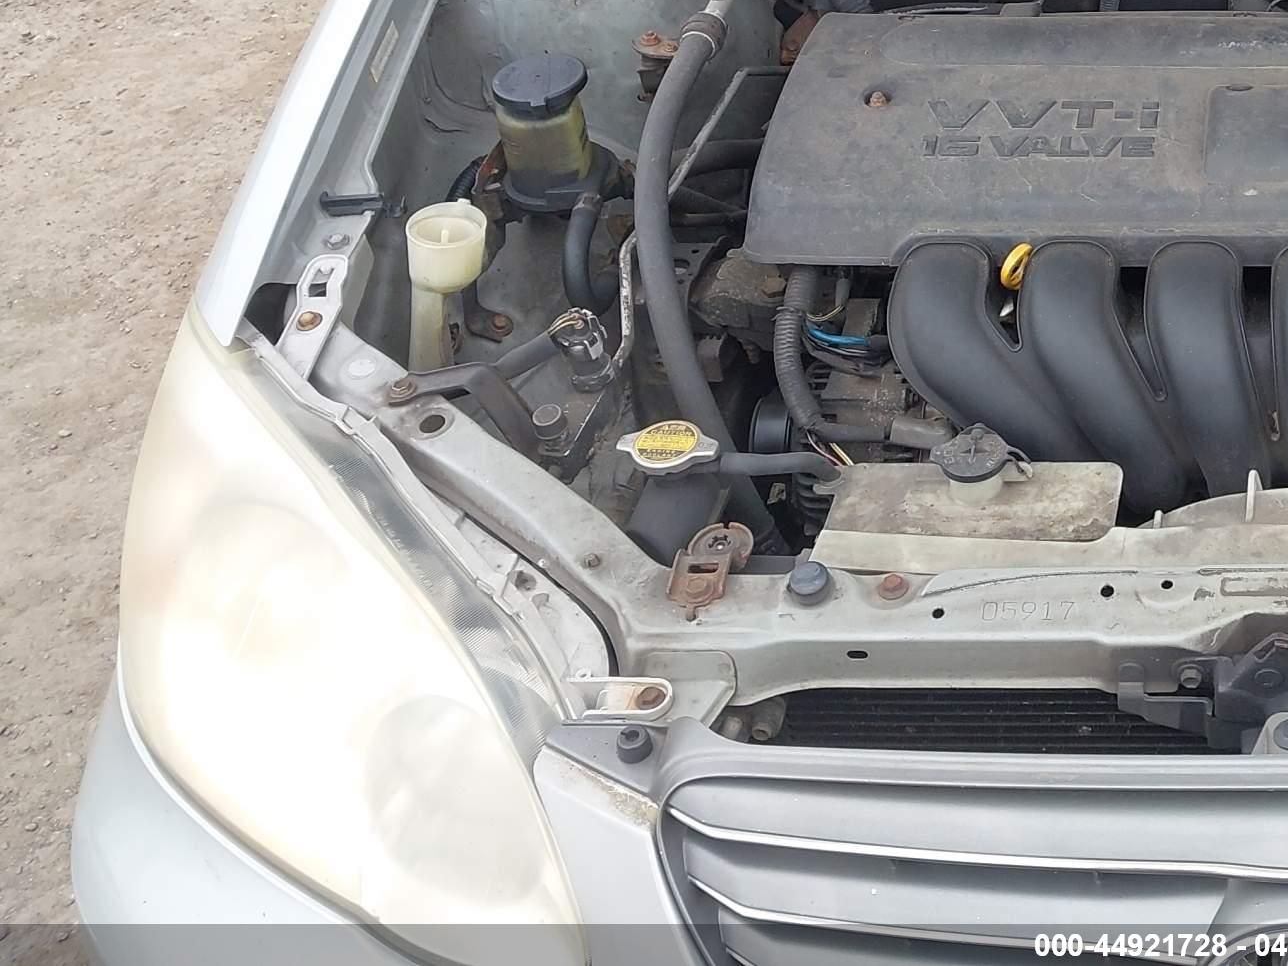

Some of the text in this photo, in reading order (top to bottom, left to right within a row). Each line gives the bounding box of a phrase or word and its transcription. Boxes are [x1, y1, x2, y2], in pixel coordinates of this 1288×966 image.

[927, 99, 1161, 130] VVT-i
[923, 135, 1156, 158] 16 VALVE
[651, 429, 693, 437] CAUTION
[981, 601, 1076, 621] 05917
